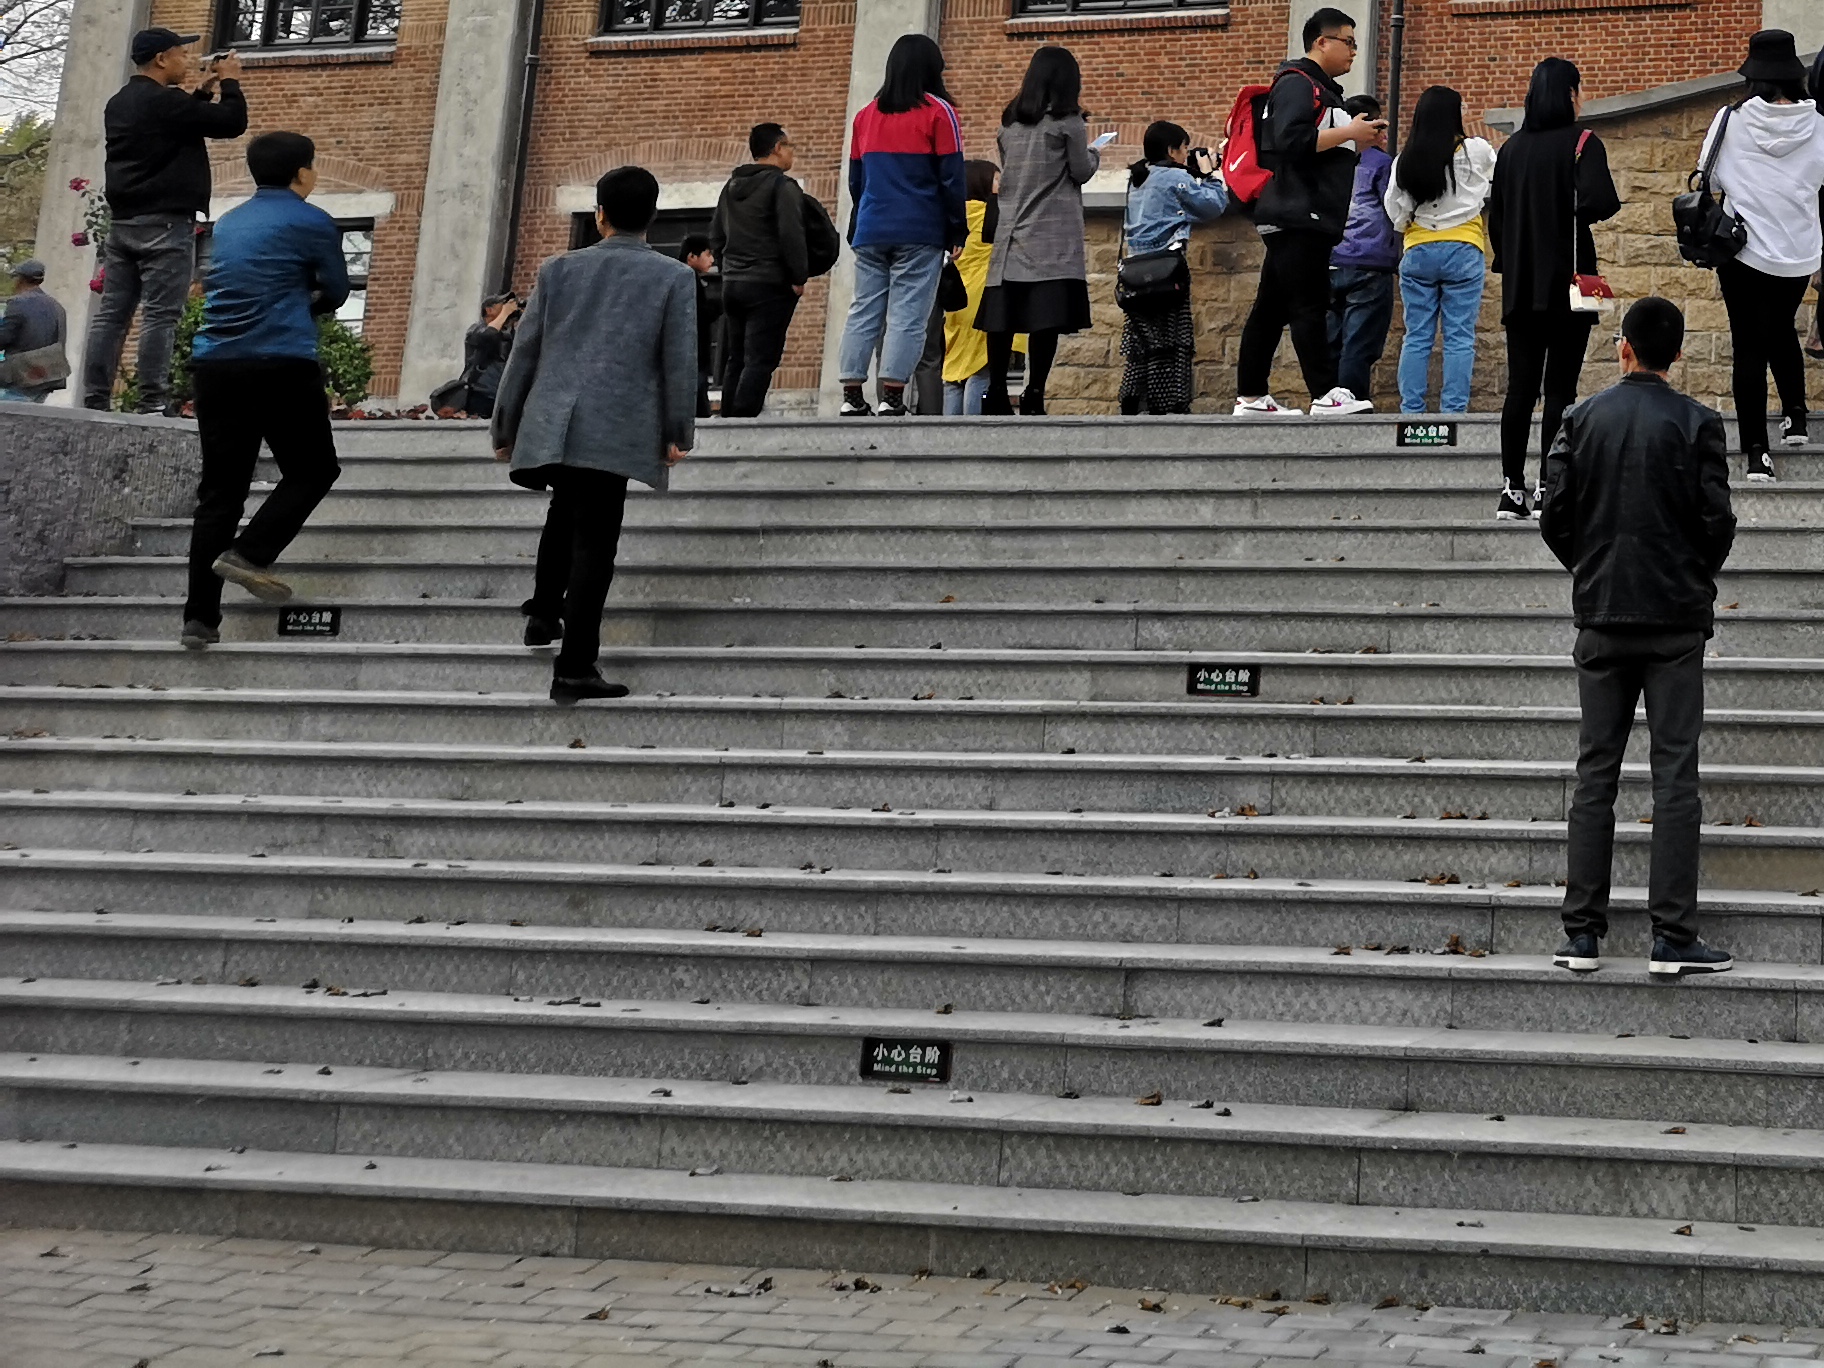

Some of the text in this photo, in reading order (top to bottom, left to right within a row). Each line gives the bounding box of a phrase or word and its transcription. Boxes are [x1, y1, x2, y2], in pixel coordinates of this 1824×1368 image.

[1404, 424, 1450, 437] 小心台阶
[286, 611, 333, 623] 小心台阶
[1196, 668, 1251, 683] 小心台阶
[1196, 683, 1216, 691] Mind
[1231, 684, 1249, 692] Step
[873, 1043, 941, 1064] 小心台阶
[873, 1062, 938, 1076] Mind the Step
